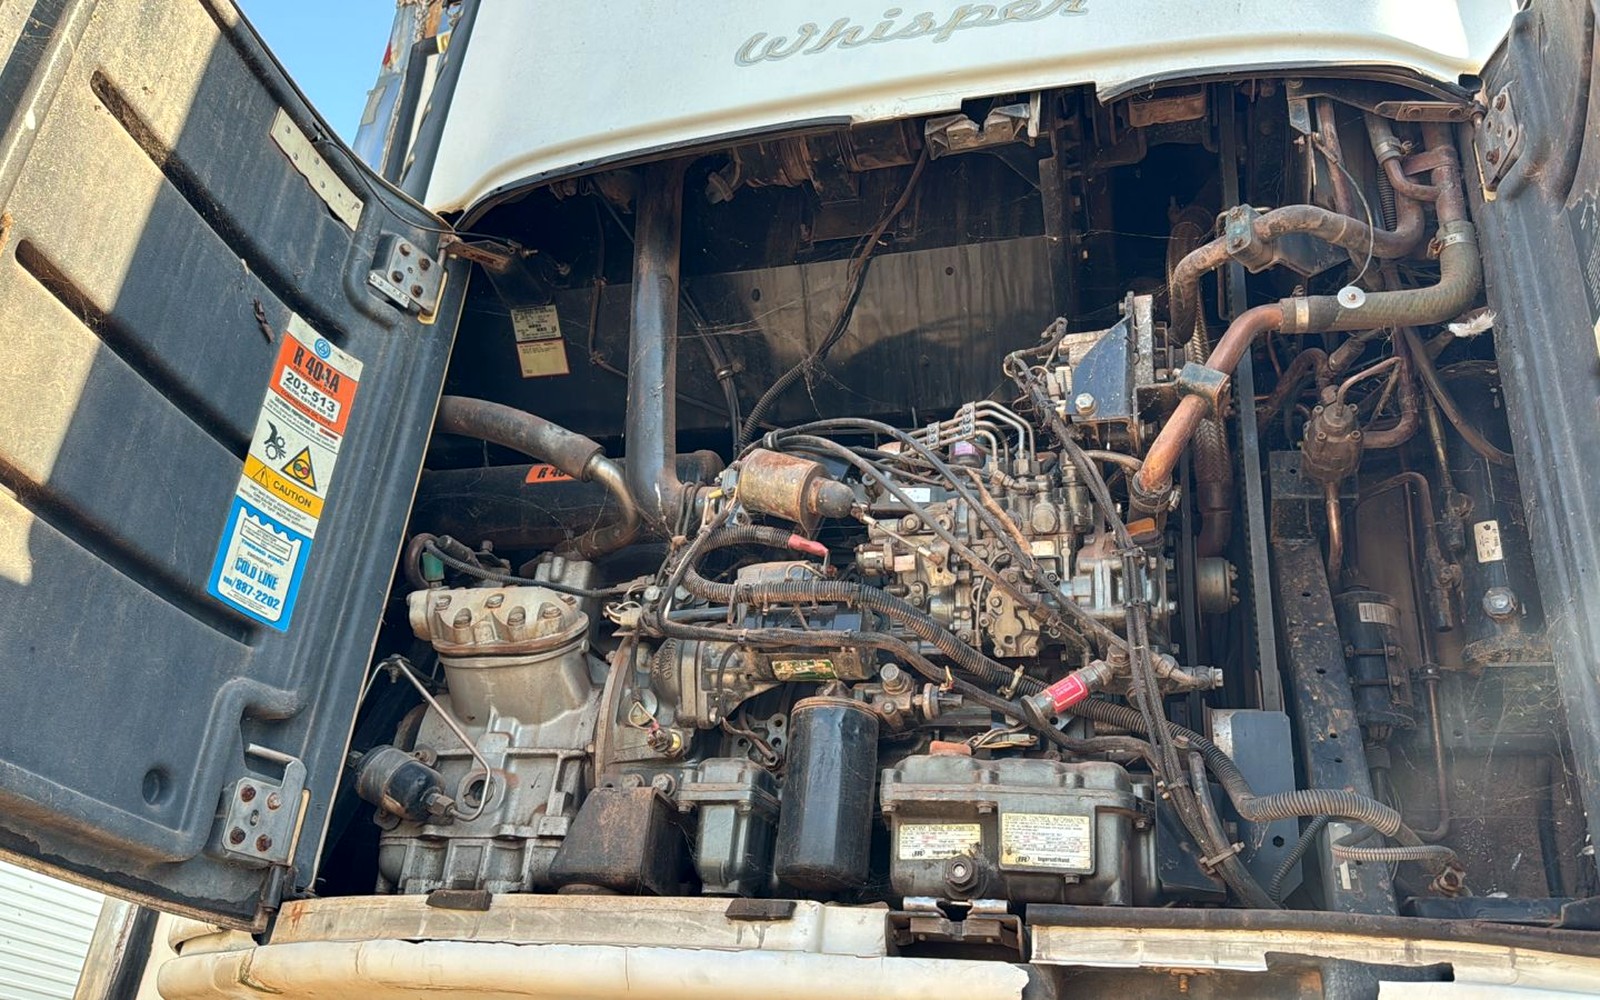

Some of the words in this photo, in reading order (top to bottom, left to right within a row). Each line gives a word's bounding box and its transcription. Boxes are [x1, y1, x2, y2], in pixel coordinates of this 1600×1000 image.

[293, 346, 304, 367] R
[286, 372, 335, 412] 203-513
[273, 480, 312, 508] CAUTION
[234, 557, 257, 579] COLD
[257, 568, 279, 591] LINE
